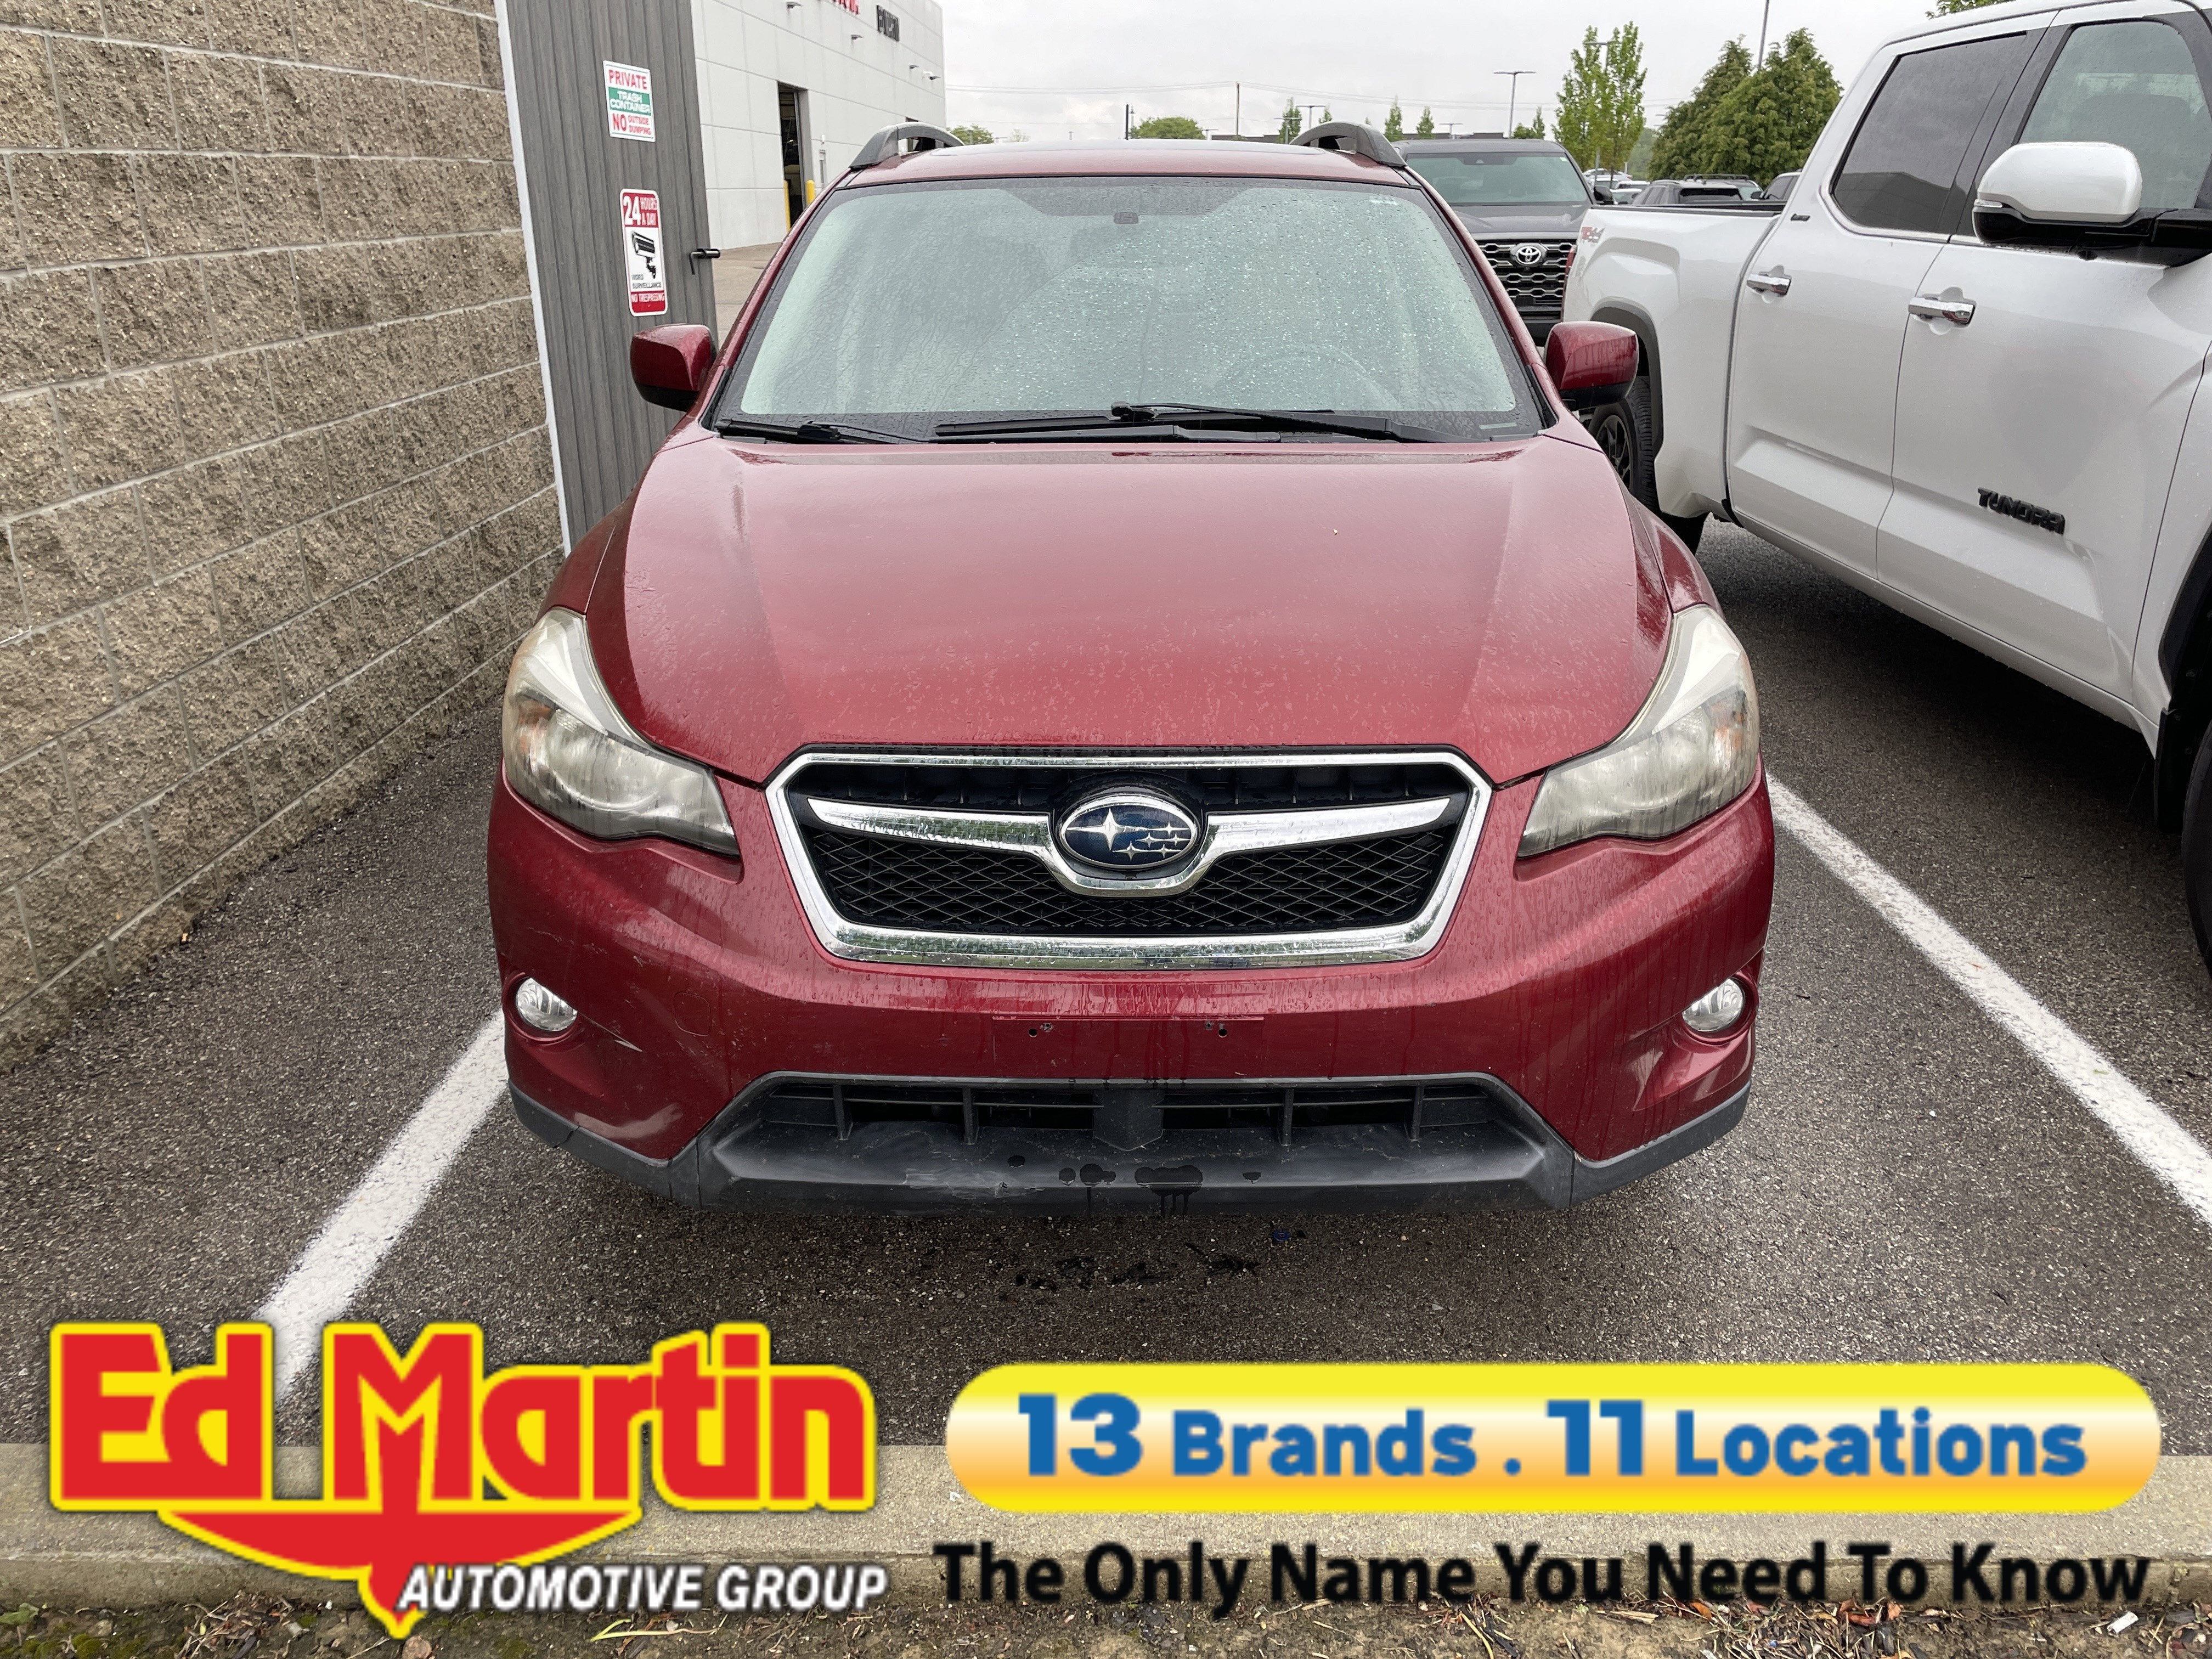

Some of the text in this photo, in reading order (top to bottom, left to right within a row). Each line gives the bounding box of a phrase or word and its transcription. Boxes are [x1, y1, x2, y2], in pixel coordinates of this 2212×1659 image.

[608, 69, 647, 90] PRIVATE
[617, 90, 643, 103] TRASH
[610, 98, 650, 114] CONTAINER
[612, 113, 627, 132] NO
[629, 125, 651, 136] DUMPING
[623, 195, 658, 225] 24 HOURS
[641, 212, 657, 225] A DAY
[1977, 487, 2066, 535] TUNDRA
